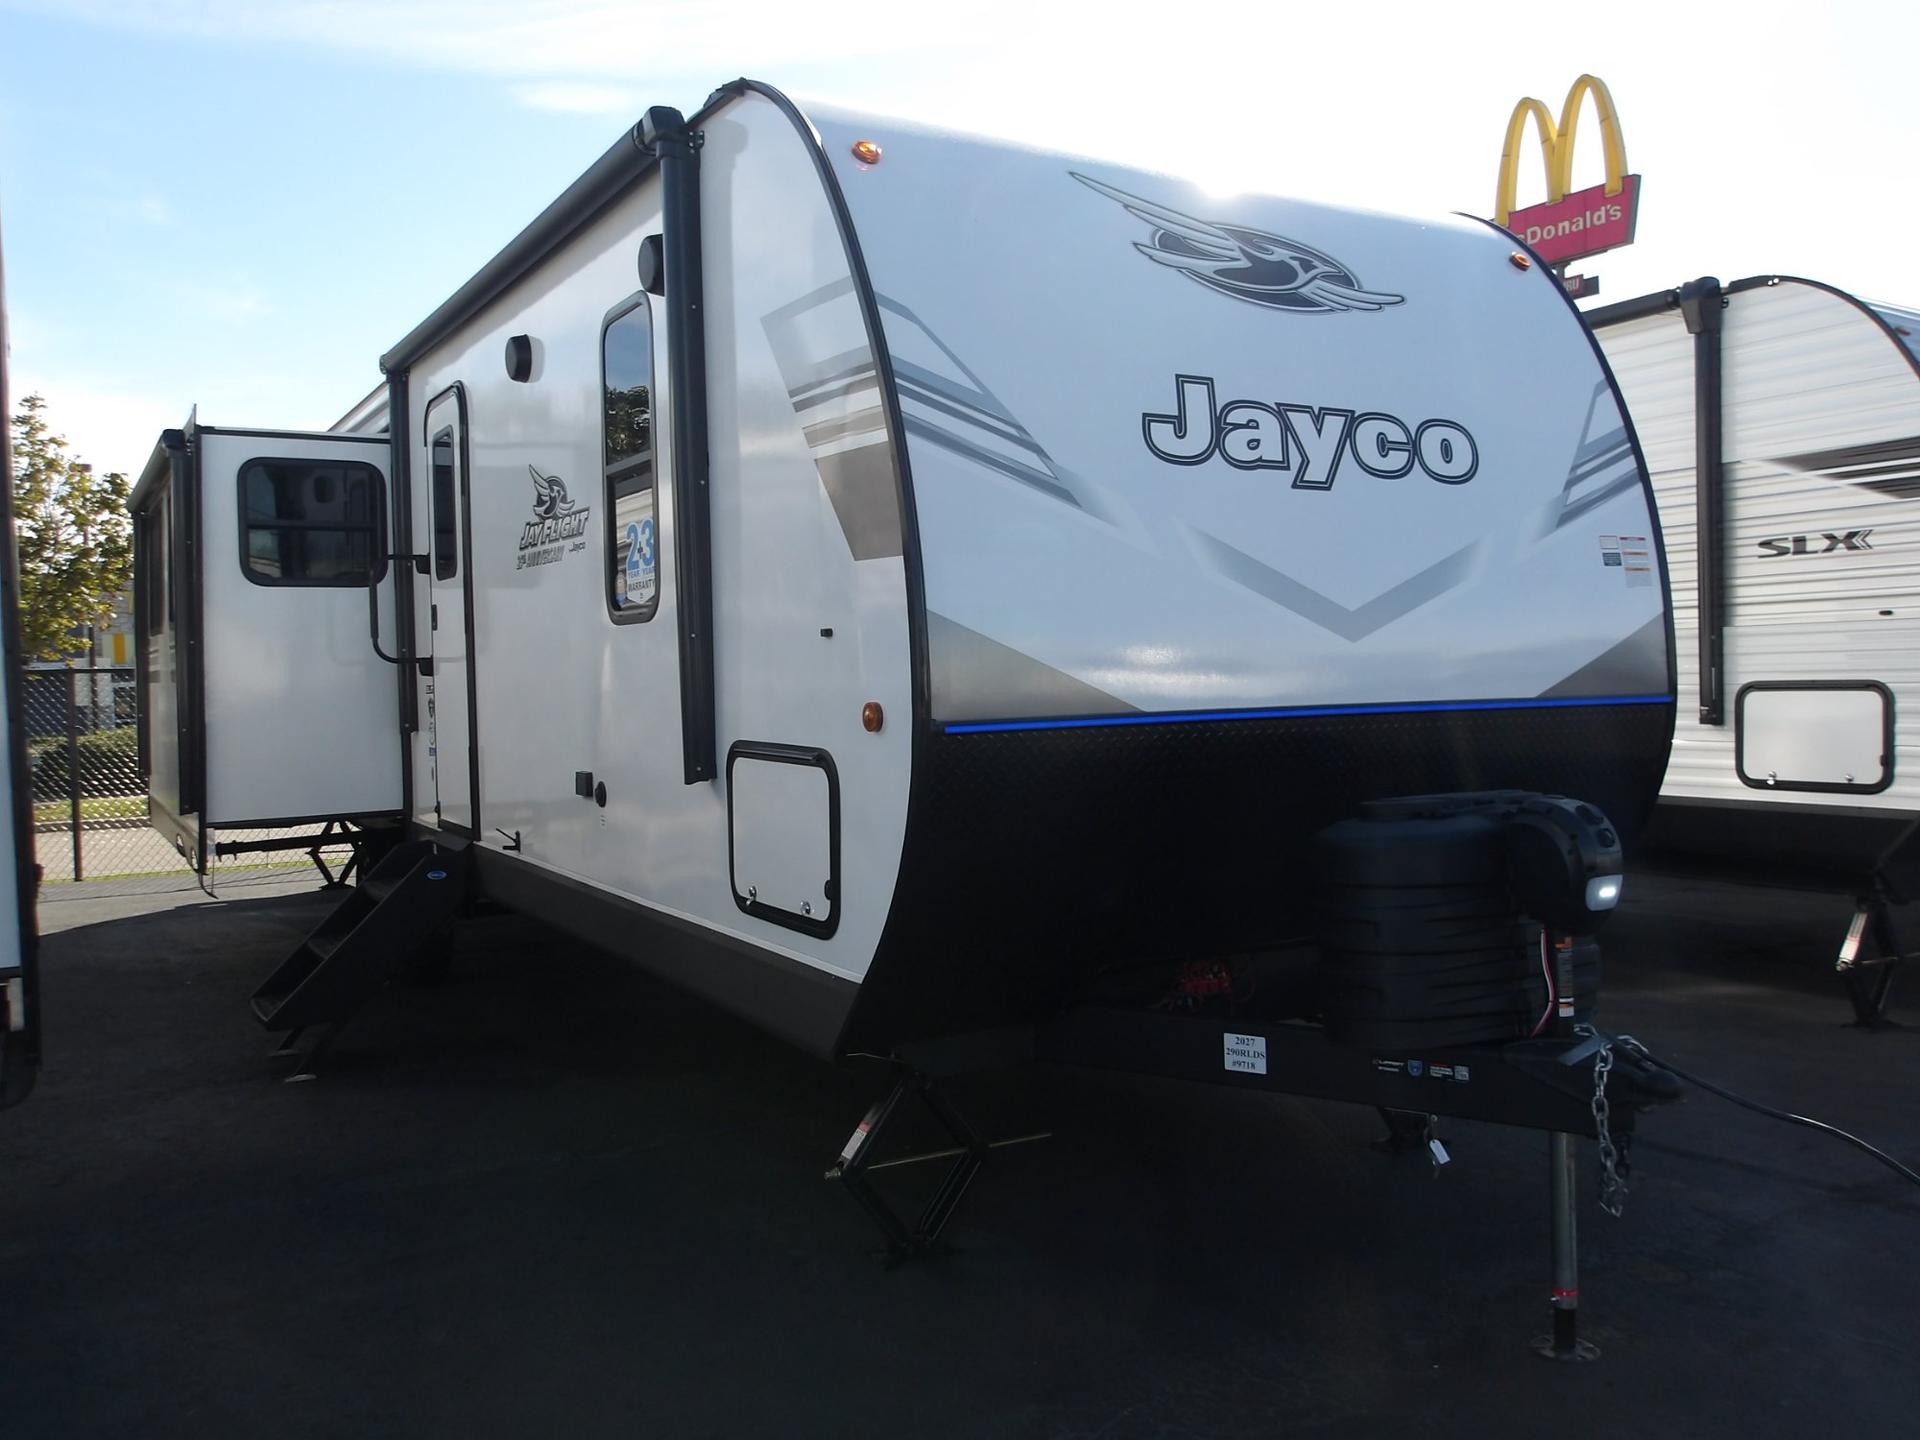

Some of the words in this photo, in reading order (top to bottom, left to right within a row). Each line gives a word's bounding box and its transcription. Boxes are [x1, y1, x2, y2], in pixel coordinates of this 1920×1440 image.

[1517, 204, 1622, 245] Donald's
[1142, 374, 1479, 491] Jayco
[1758, 530, 1872, 558] SLX
[1235, 1036, 1256, 1047] 2027
